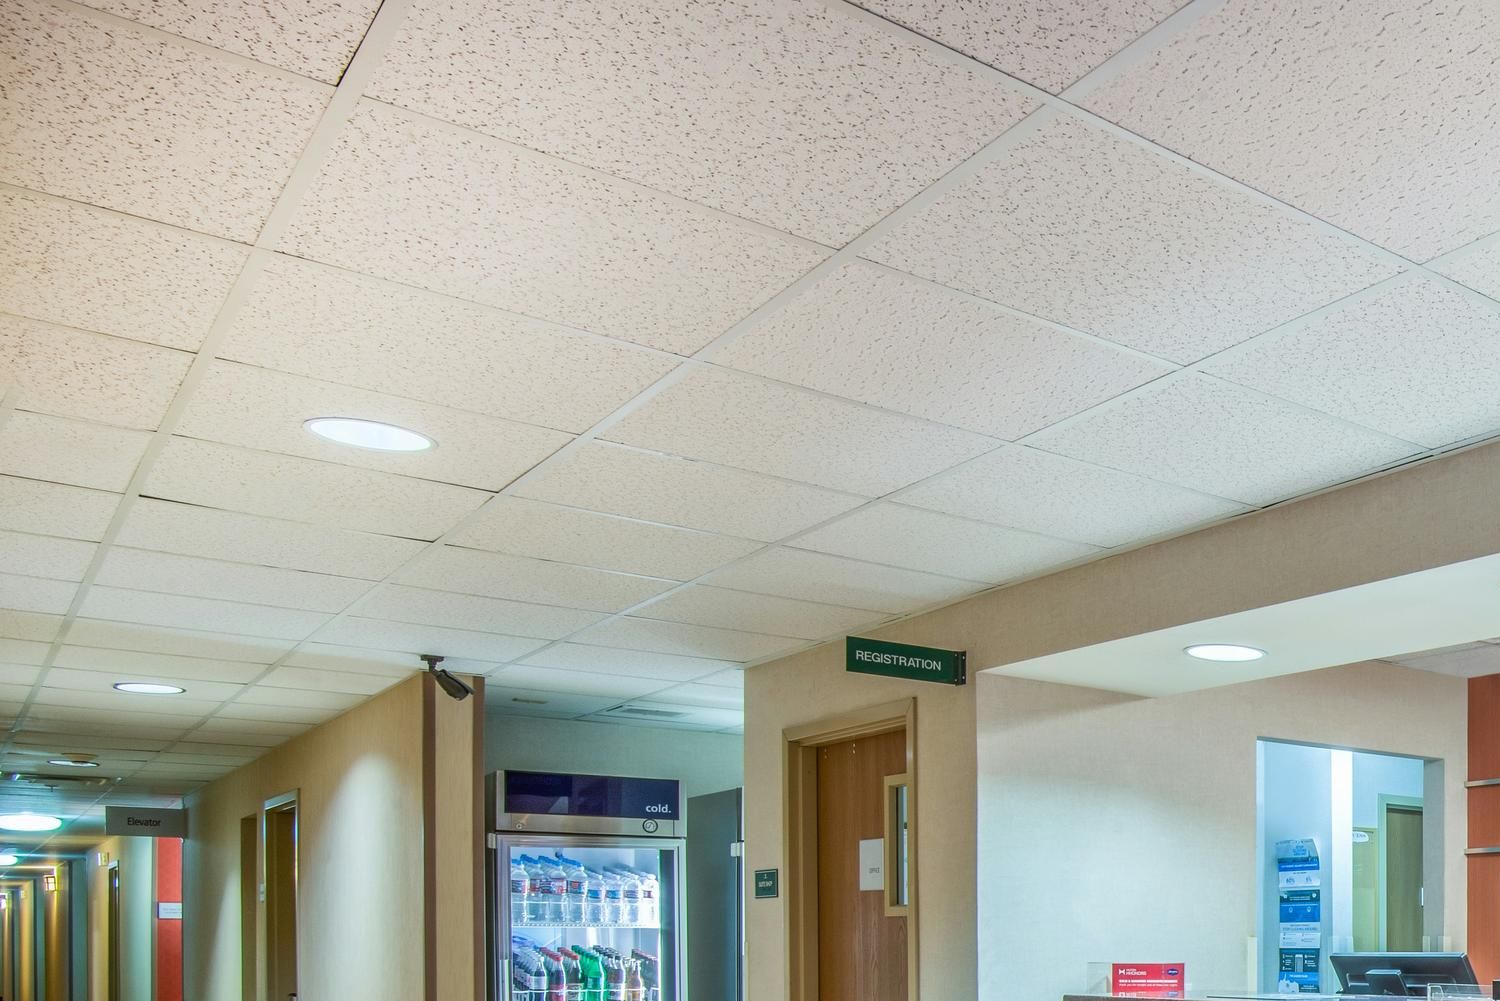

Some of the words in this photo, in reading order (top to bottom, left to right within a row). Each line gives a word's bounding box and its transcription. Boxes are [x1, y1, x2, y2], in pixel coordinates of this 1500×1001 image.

[855, 649, 942, 671] REGISTRATION
[645, 804, 672, 814] cold.
[127, 816, 161, 827] Elevator
